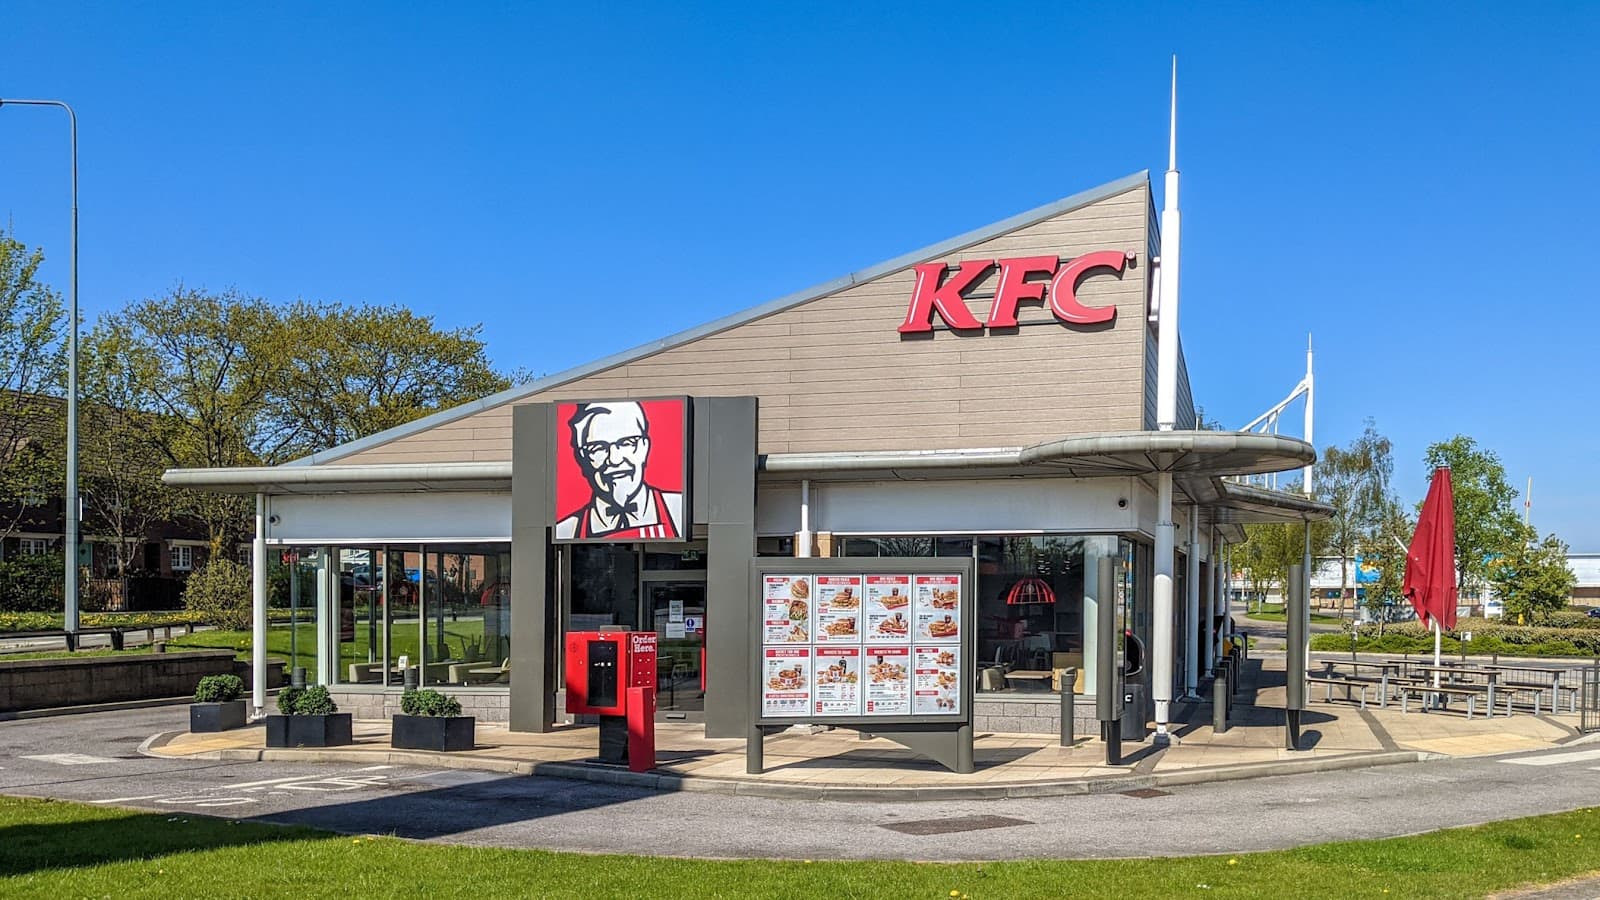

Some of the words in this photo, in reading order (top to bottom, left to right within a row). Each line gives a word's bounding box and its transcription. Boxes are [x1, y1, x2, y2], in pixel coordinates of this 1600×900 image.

[897, 250, 1127, 333] KFC
[633, 635, 656, 643] Order
[156, 775, 390, 807] SOP
